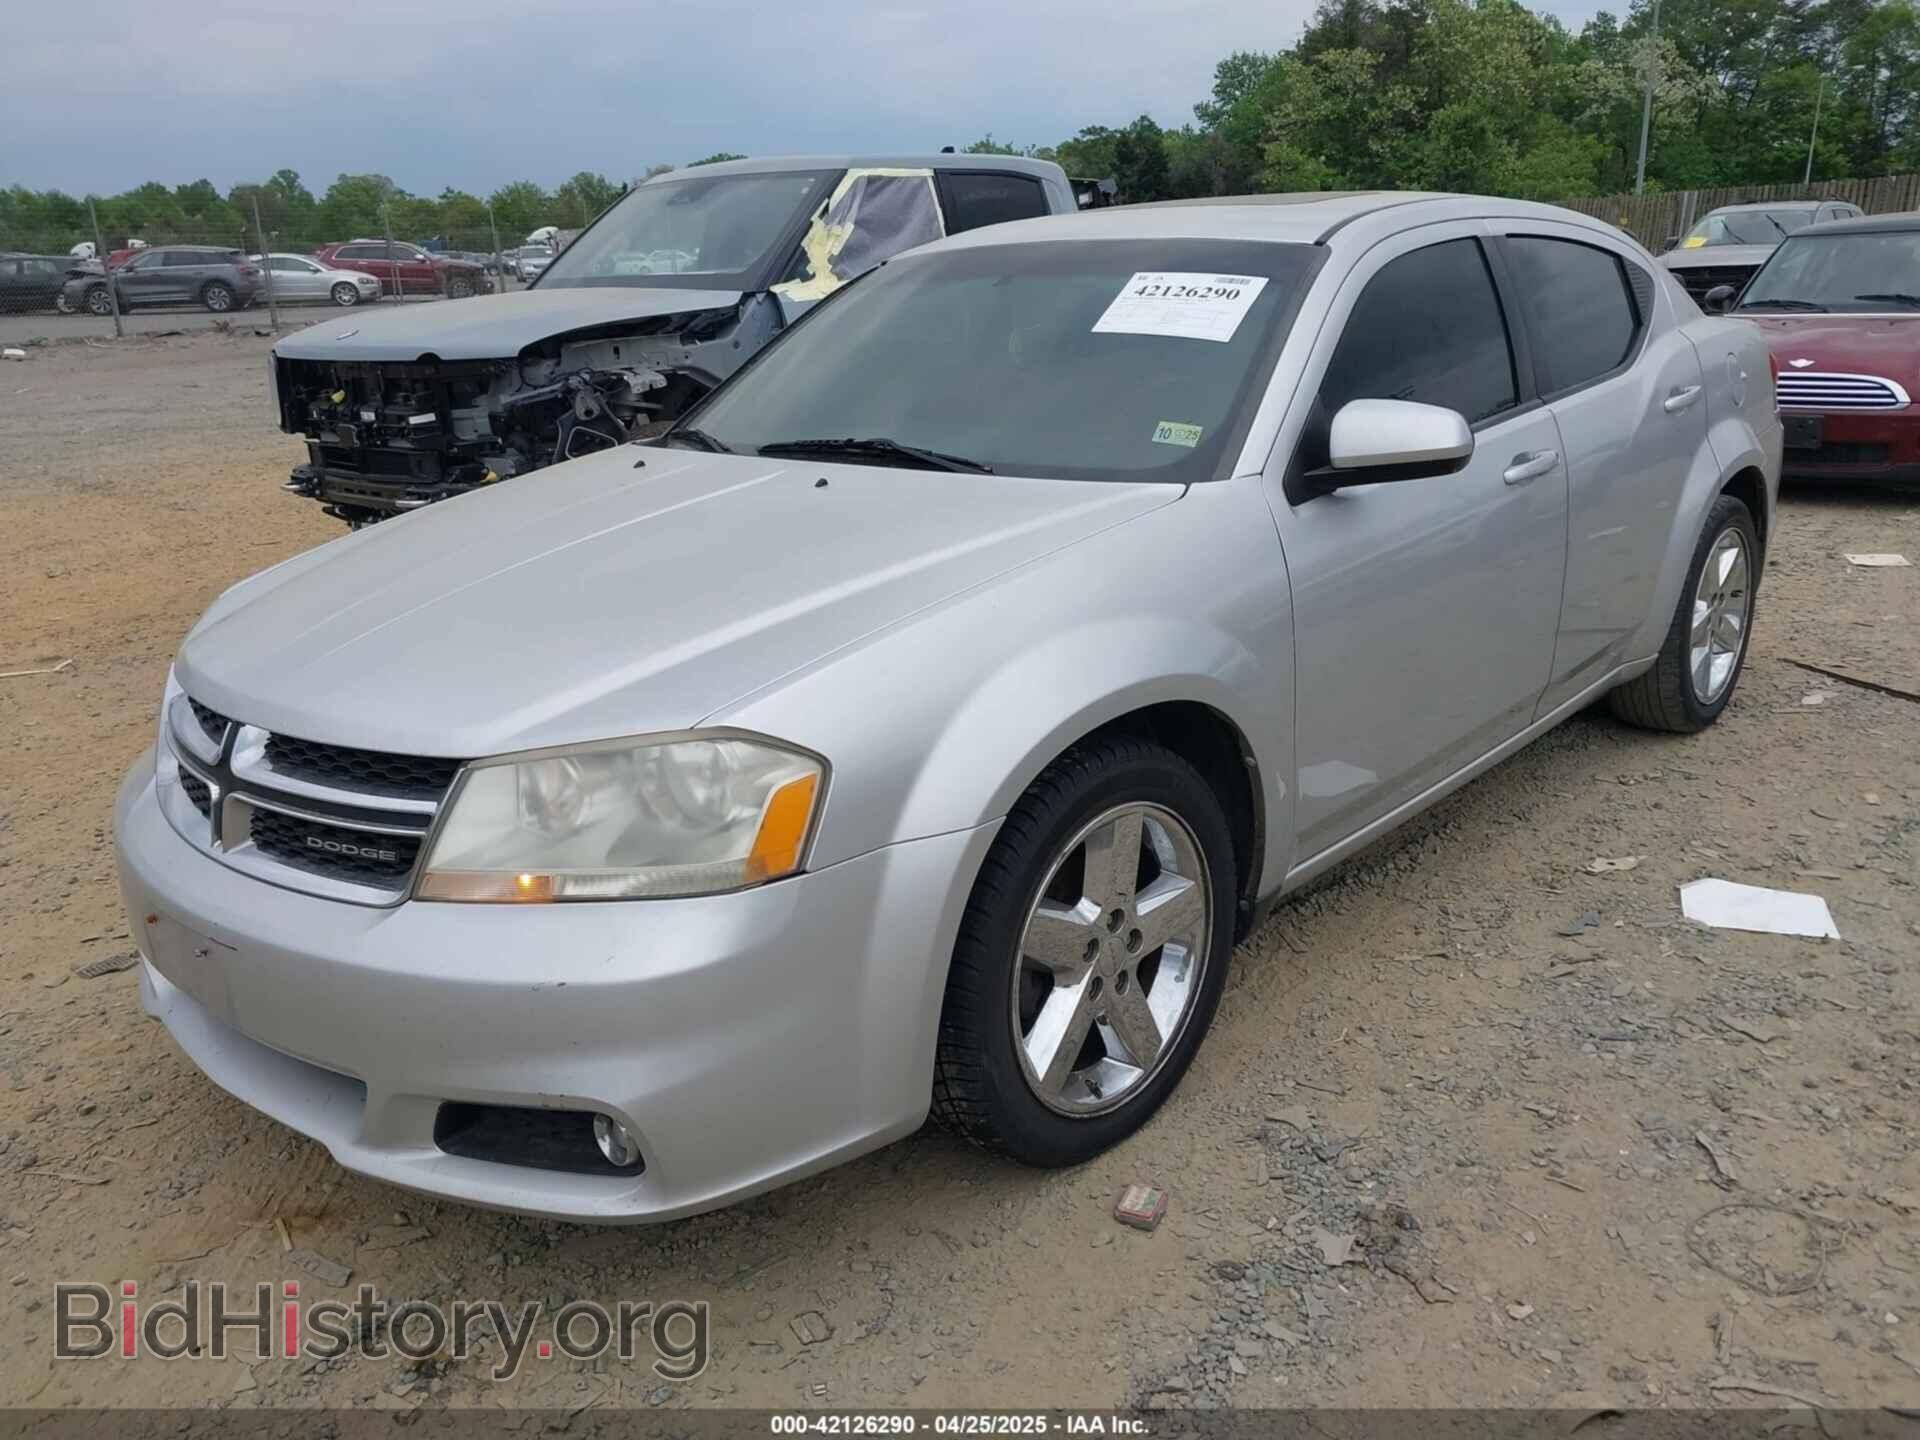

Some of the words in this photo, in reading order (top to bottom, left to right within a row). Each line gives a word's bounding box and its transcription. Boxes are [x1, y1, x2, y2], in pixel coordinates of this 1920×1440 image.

[1134, 284, 1241, 301] 42126290
[1159, 426, 1172, 440] 10
[307, 837, 396, 861] DODGE
